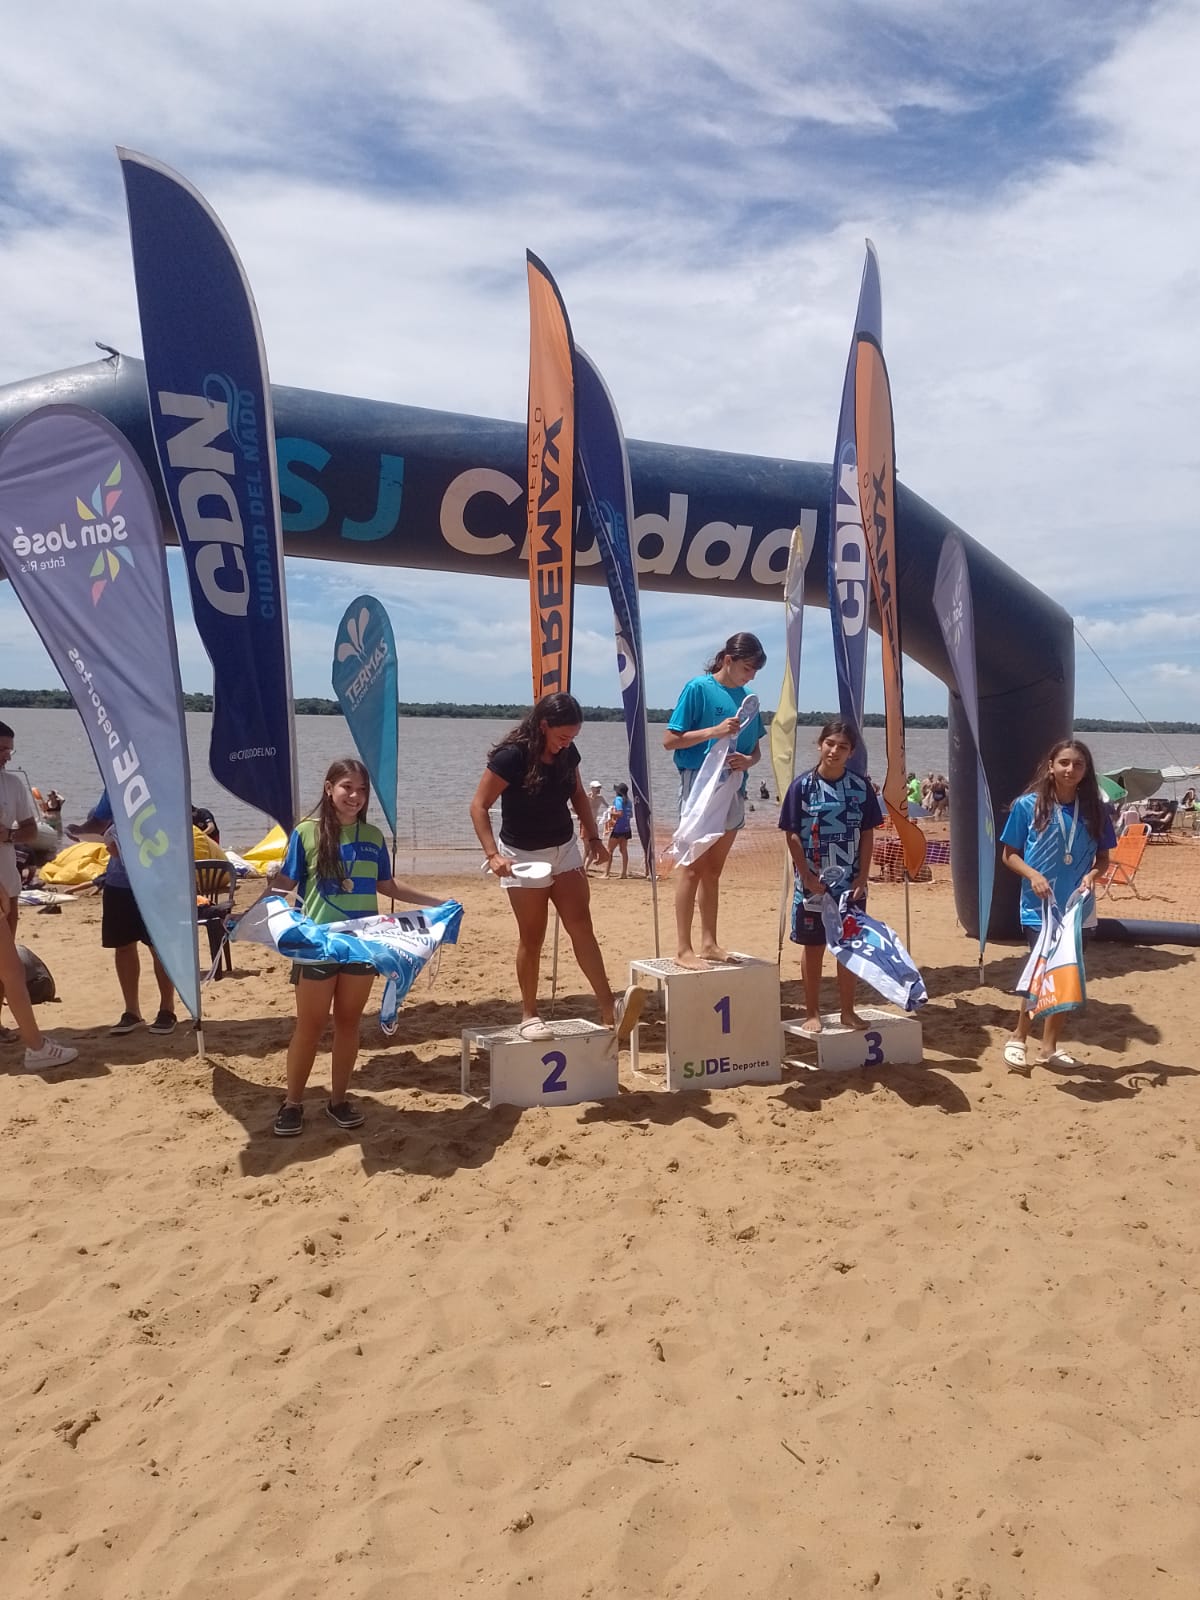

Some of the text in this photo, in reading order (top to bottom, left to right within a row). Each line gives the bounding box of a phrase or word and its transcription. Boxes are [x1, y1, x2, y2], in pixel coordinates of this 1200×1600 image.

[158, 391, 250, 617] CDN
[239, 389, 277, 620] CIUDAD DEL NADO
[344, 637, 389, 706] TERMAS
[713, 995, 732, 1034] 1
[682, 1056, 771, 1079] SJDE Deportes
[864, 1031, 885, 1068] 3
[540, 1050, 568, 1094] 2
